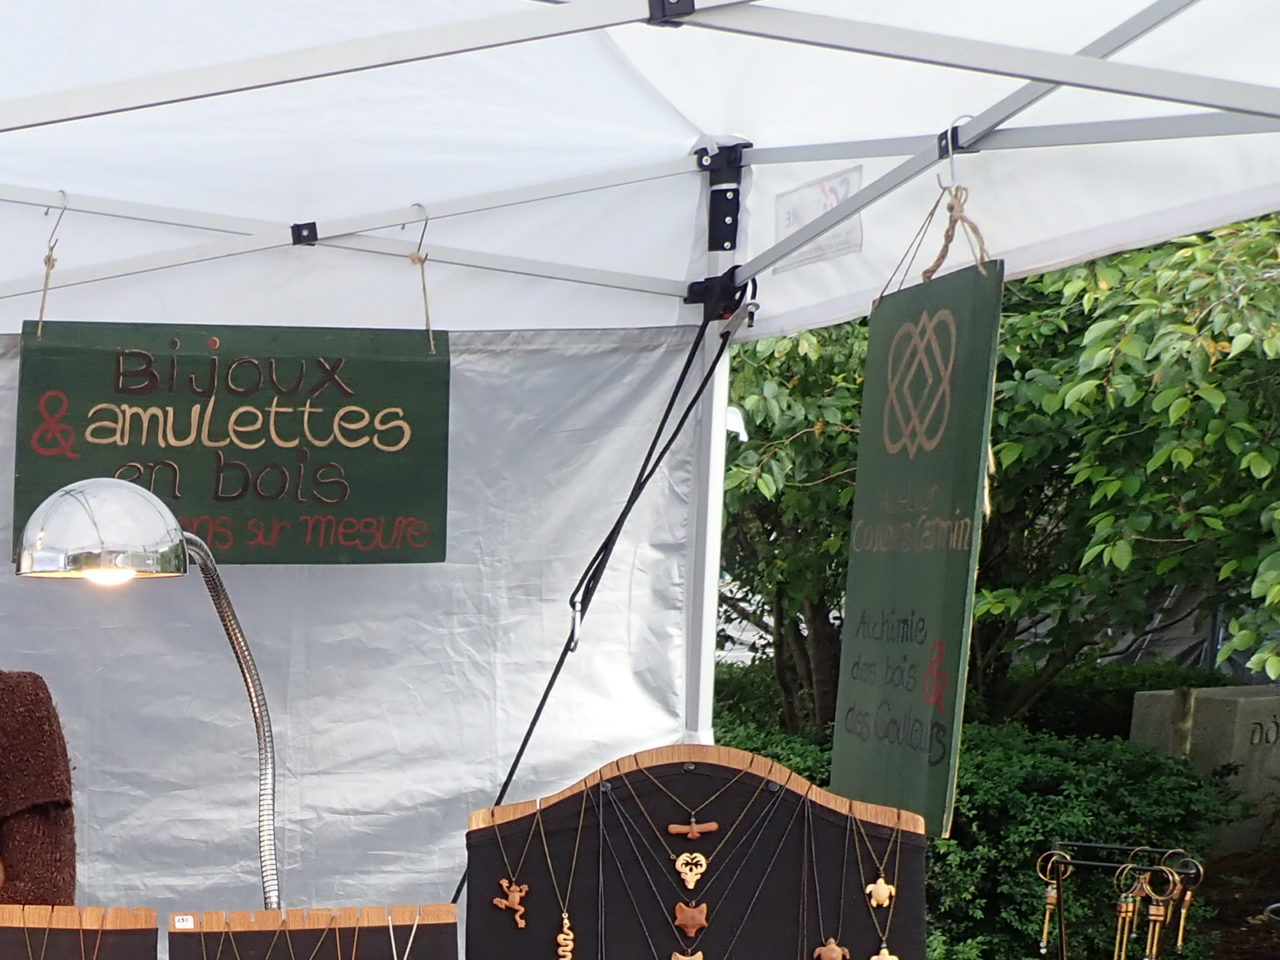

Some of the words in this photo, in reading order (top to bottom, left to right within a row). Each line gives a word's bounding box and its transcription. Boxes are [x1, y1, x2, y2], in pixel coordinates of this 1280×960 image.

[114, 337, 355, 398] Bijoux
[85, 396, 412, 452] amulettes
[214, 448, 350, 504] bois
[246, 519, 293, 549] sur
[300, 514, 431, 550] mesure
[885, 655, 917, 692] bois
